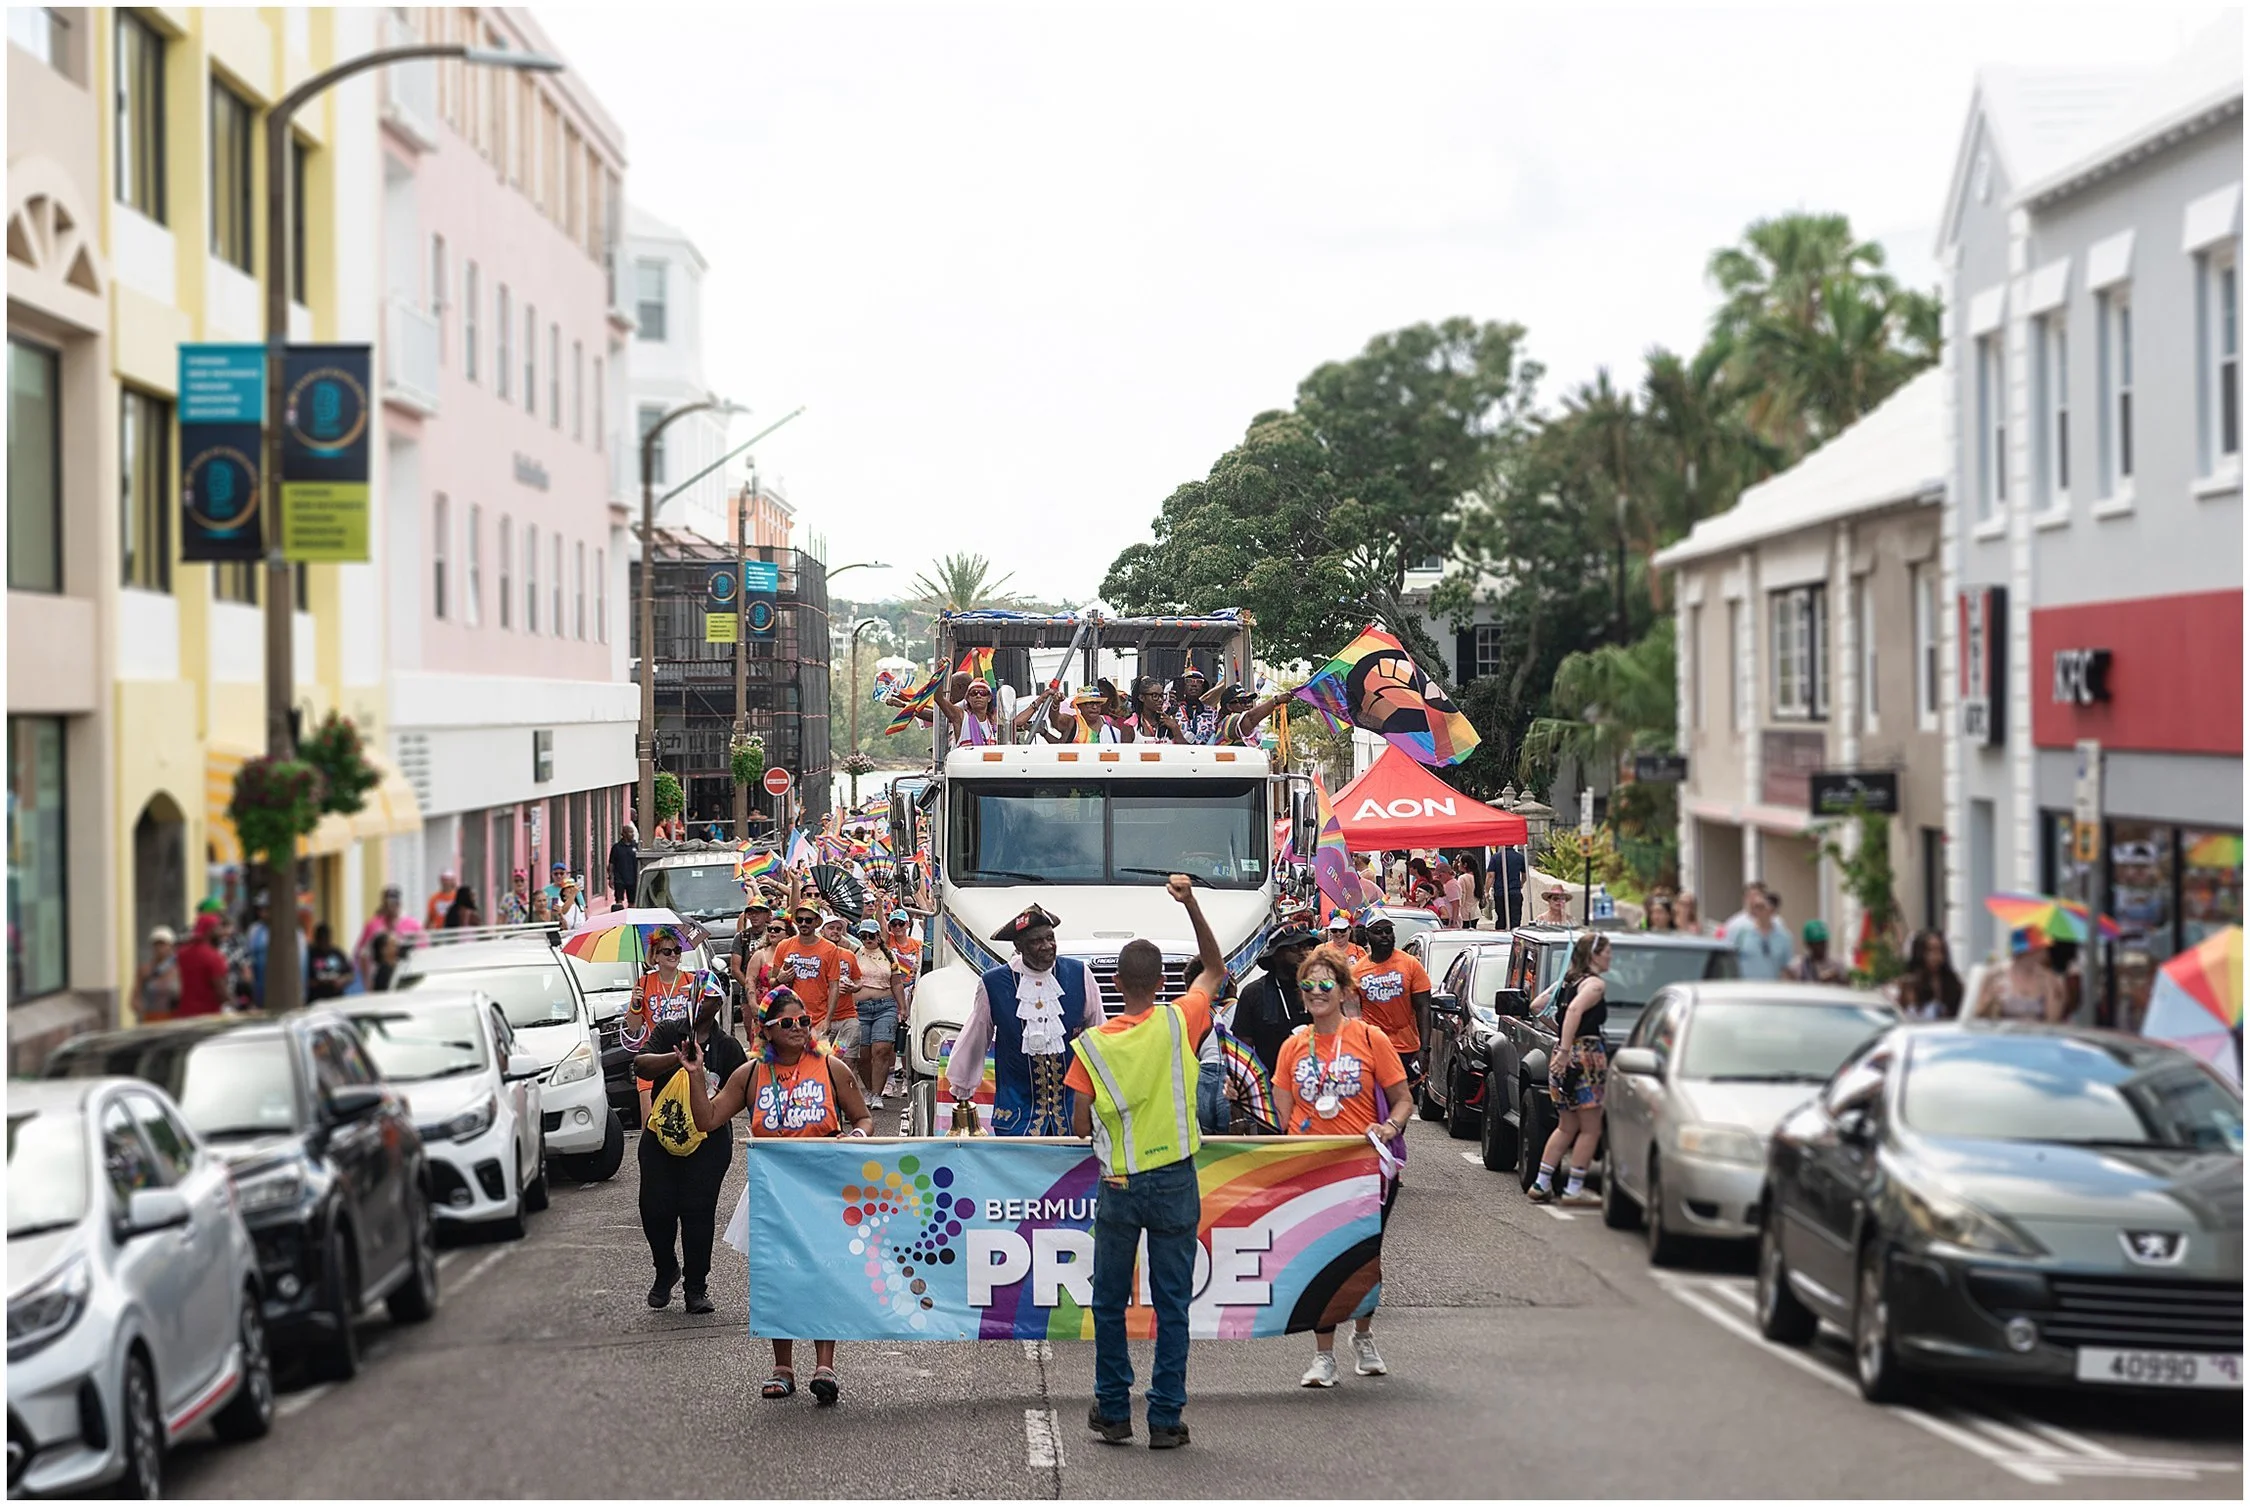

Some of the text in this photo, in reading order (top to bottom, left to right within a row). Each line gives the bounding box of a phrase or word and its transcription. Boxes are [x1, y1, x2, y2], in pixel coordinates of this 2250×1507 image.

[1351, 797, 1457, 822] AON
[789, 953, 821, 969] Family
[794, 964, 819, 980] Affair
[1360, 971, 1402, 990] Family
[1367, 985, 1403, 1001] Affair
[759, 1080, 824, 1110] Family
[764, 1103, 825, 1128] Affair
[2110, 1354, 2197, 1382] 40990
